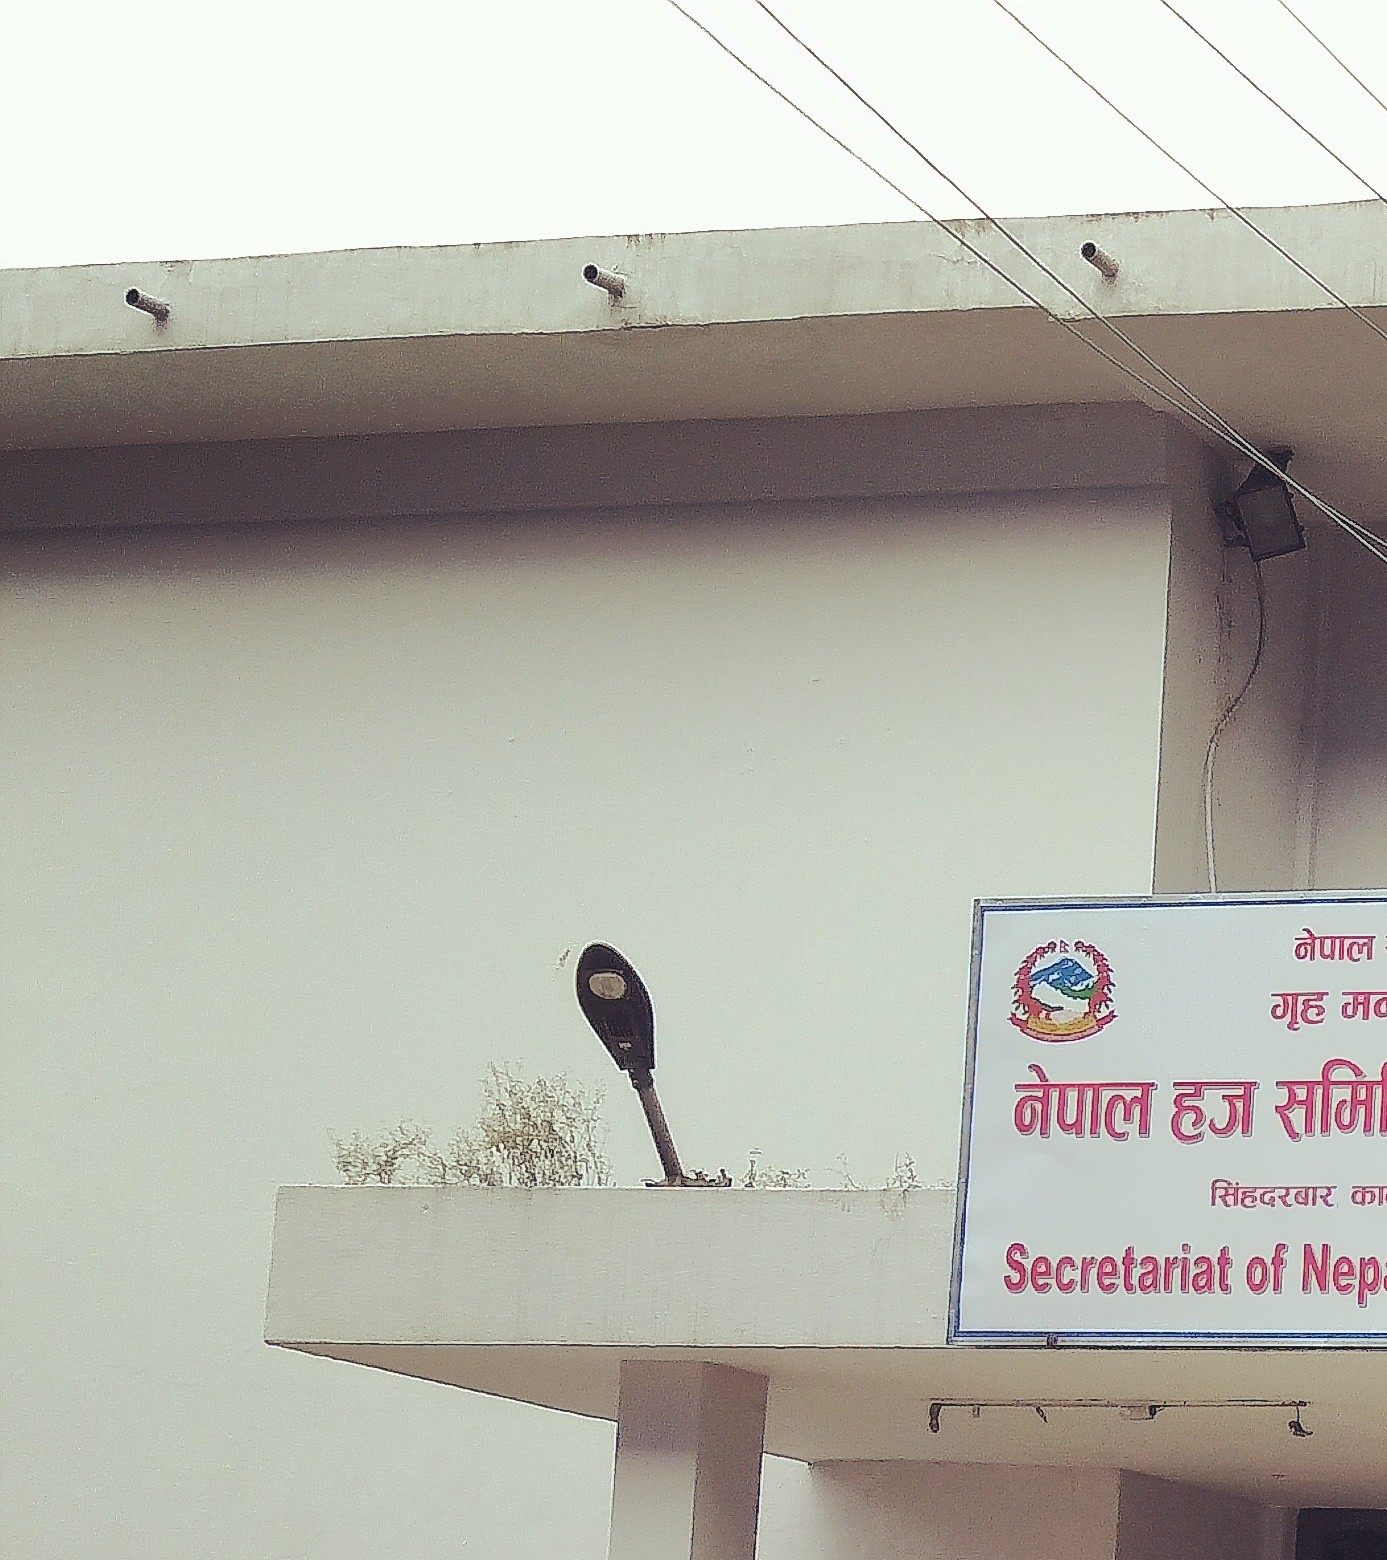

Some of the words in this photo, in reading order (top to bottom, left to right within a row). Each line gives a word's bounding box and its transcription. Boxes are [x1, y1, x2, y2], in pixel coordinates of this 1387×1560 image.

[1295, 928, 1376, 962] नेपाल
[1271, 992, 1329, 1031] गृह
[1015, 1064, 1158, 1141] नेपाल
[1171, 1081, 1260, 1145] हज
[1004, 1243, 1233, 1295] Secretariat
[1246, 1243, 1289, 1295] of
